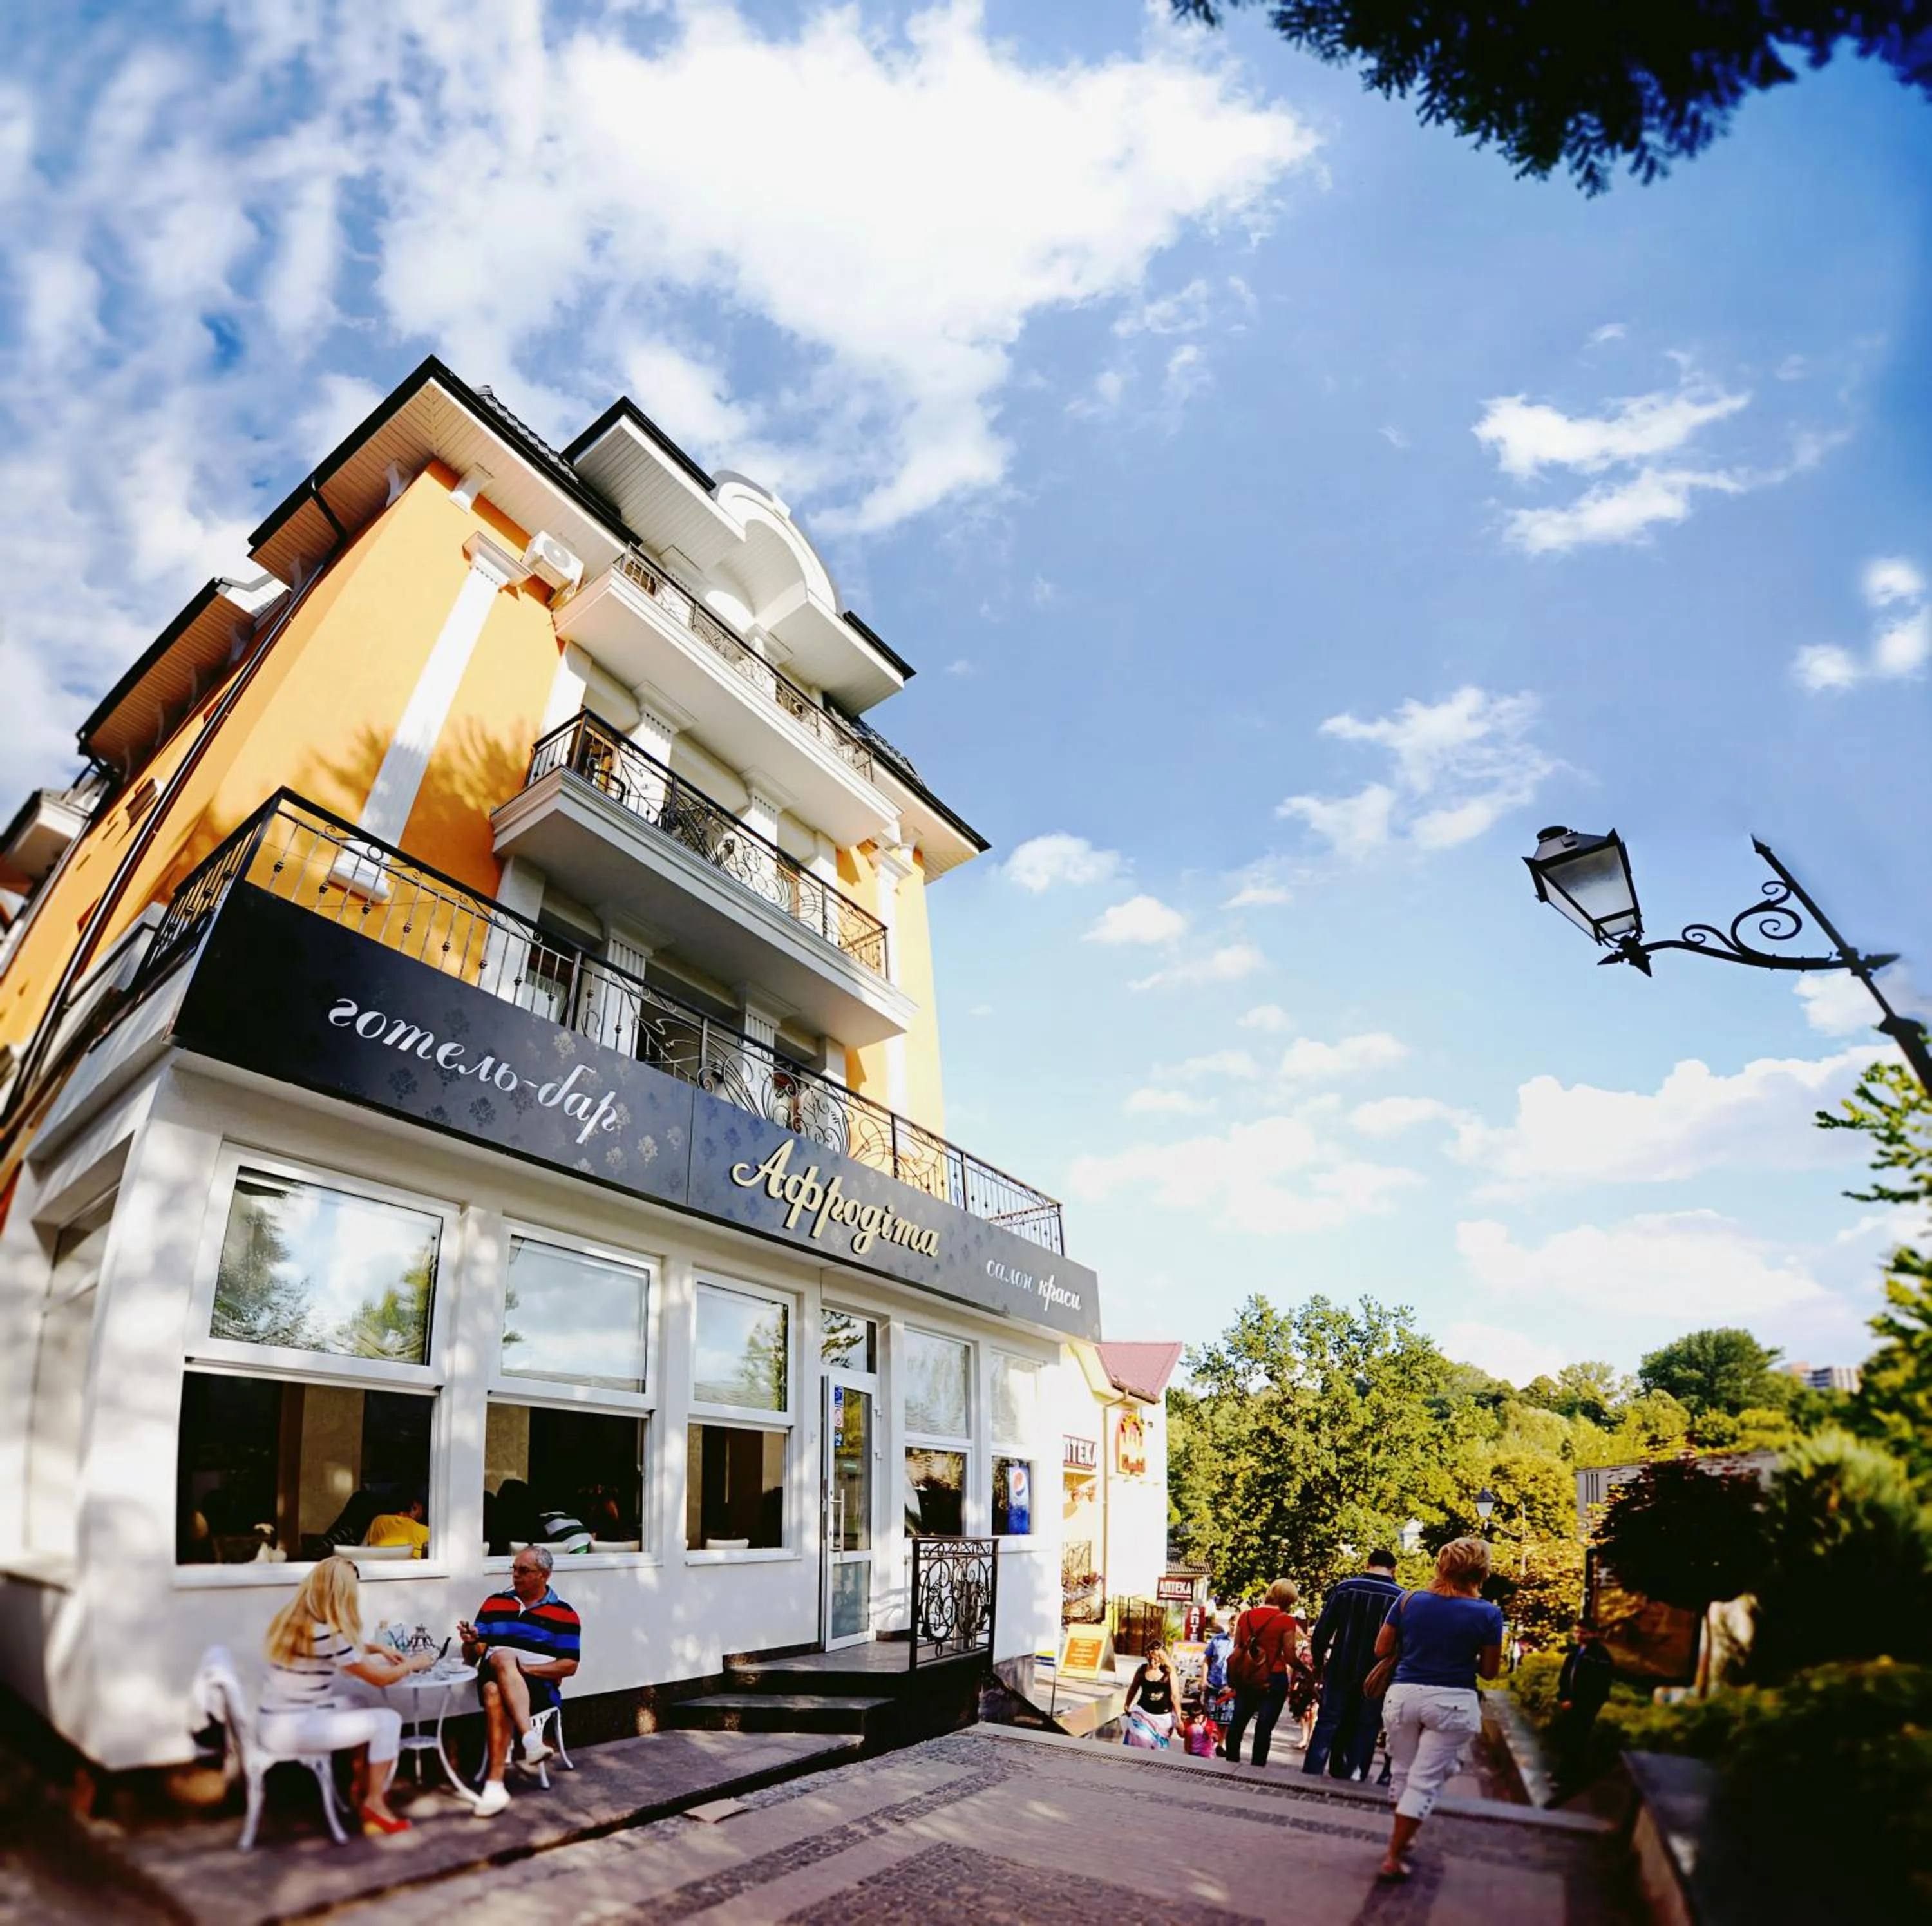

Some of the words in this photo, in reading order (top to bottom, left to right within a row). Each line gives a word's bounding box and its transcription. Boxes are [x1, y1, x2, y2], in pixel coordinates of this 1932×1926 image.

[328, 998, 617, 1144] готель-бар
[731, 1138, 939, 1255] Афродіта
[986, 1259, 1034, 1292] салон
[1038, 1274, 1081, 1312] краси
[1063, 1437, 1097, 1465] ПТЕК
[1159, 1580, 1192, 1594] АПТЕКА
[1190, 1607, 1200, 1642] АПТЕ
